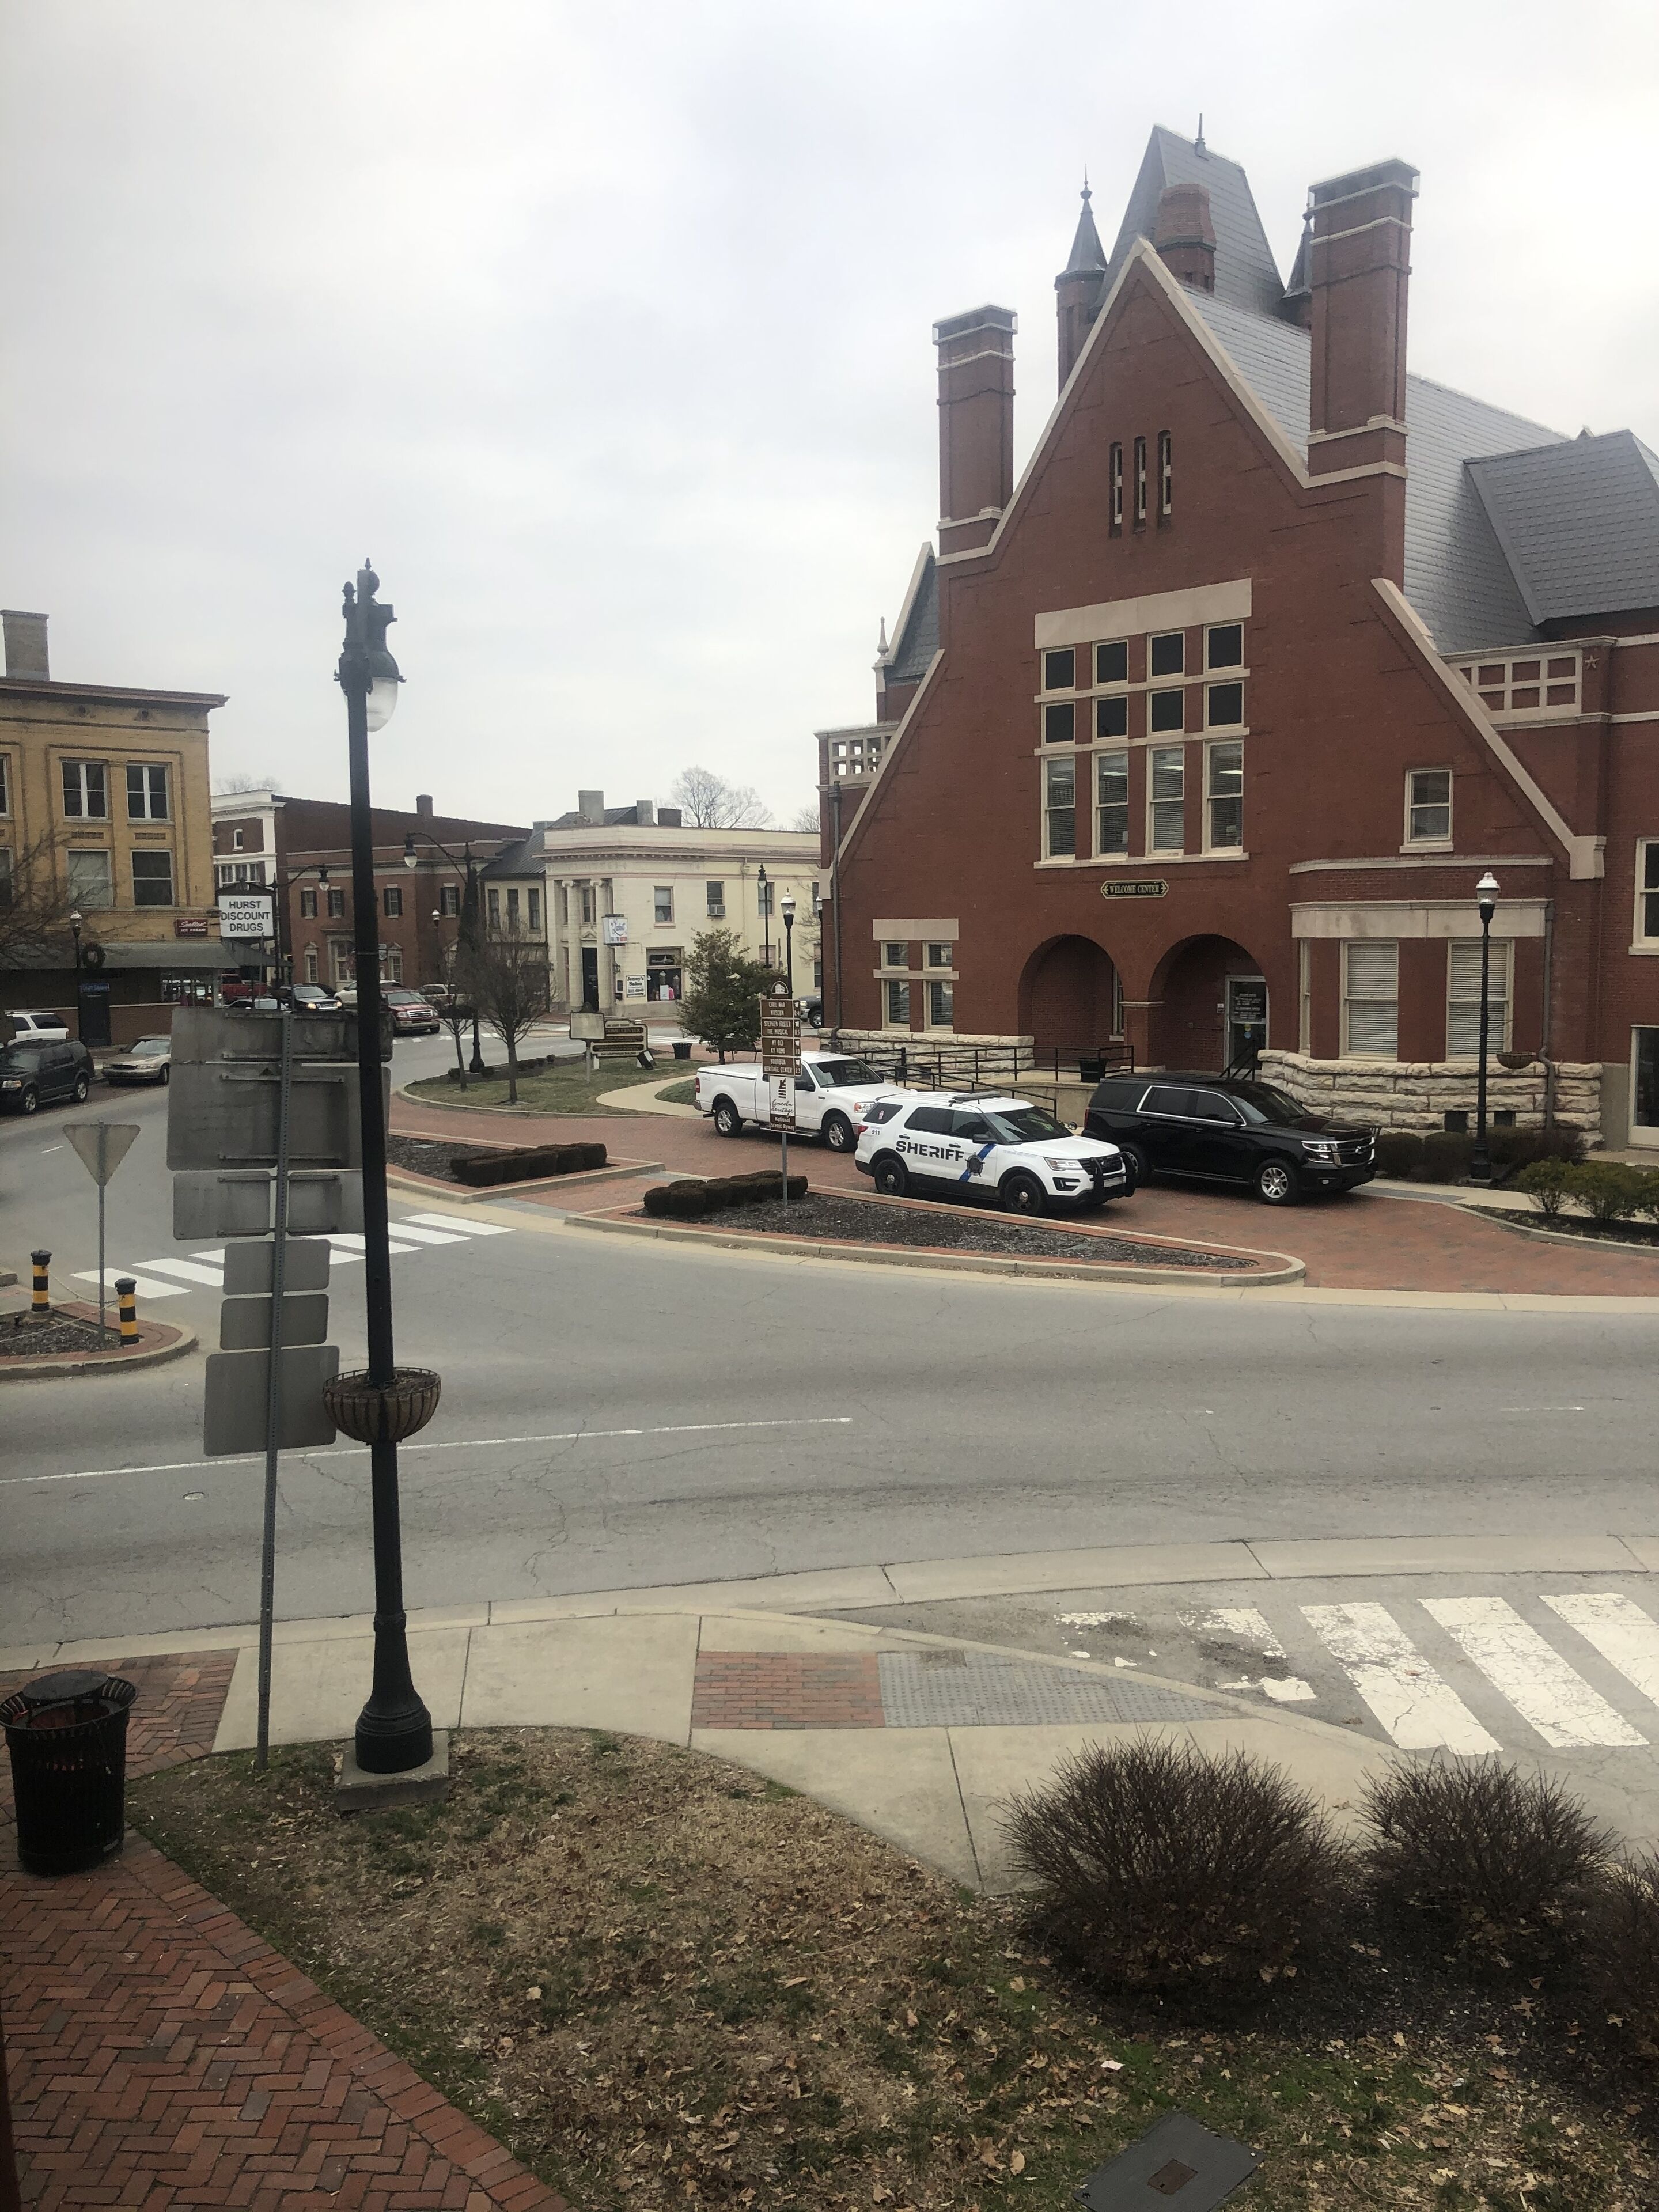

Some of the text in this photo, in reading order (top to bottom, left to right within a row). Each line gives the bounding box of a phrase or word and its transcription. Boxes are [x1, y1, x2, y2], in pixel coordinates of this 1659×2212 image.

[1109, 884, 1159, 893] WELCOME CENTER
[229, 901, 262, 909] HURST
[221, 912, 270, 921] DISCOUNT
[230, 923, 263, 931] DRUGS
[896, 1141, 964, 1161] SHERIFF
